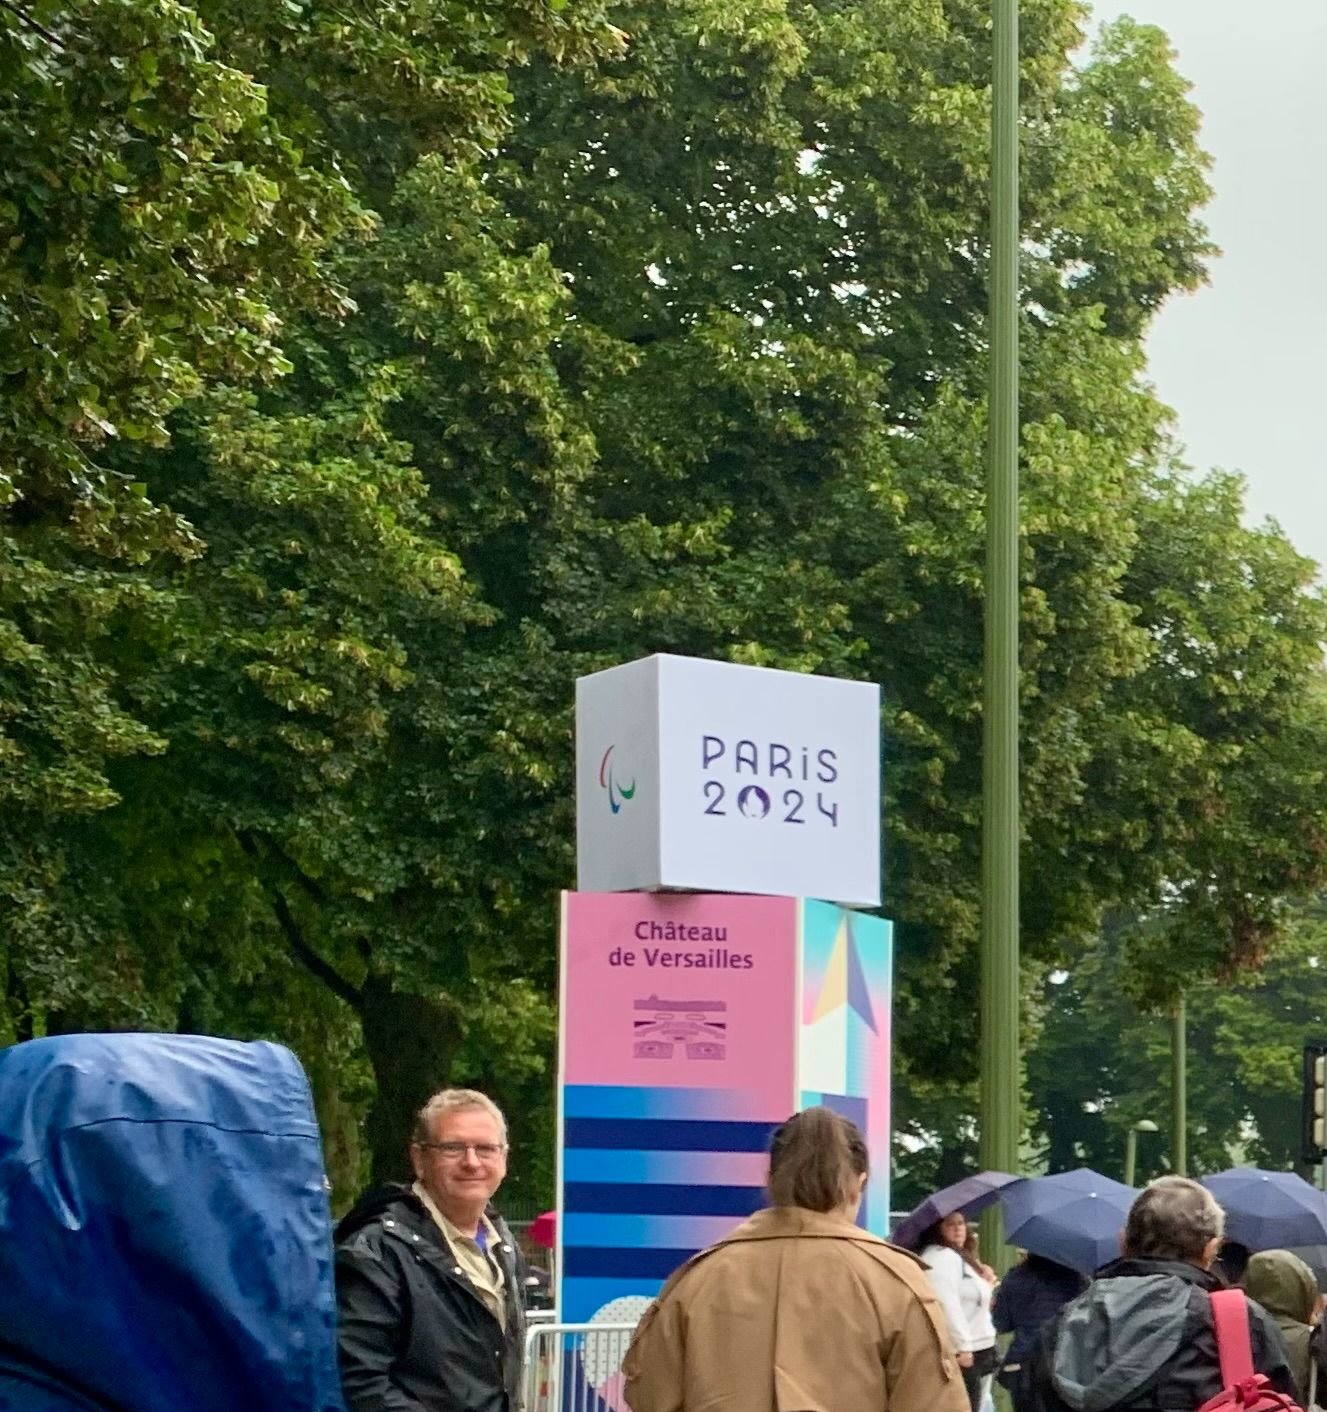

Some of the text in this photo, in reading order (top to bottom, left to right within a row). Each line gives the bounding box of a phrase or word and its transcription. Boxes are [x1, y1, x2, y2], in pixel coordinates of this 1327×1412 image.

[703, 781, 838, 827] 2024
[634, 920, 728, 943] Château
[608, 947, 754, 970] de Versailles
